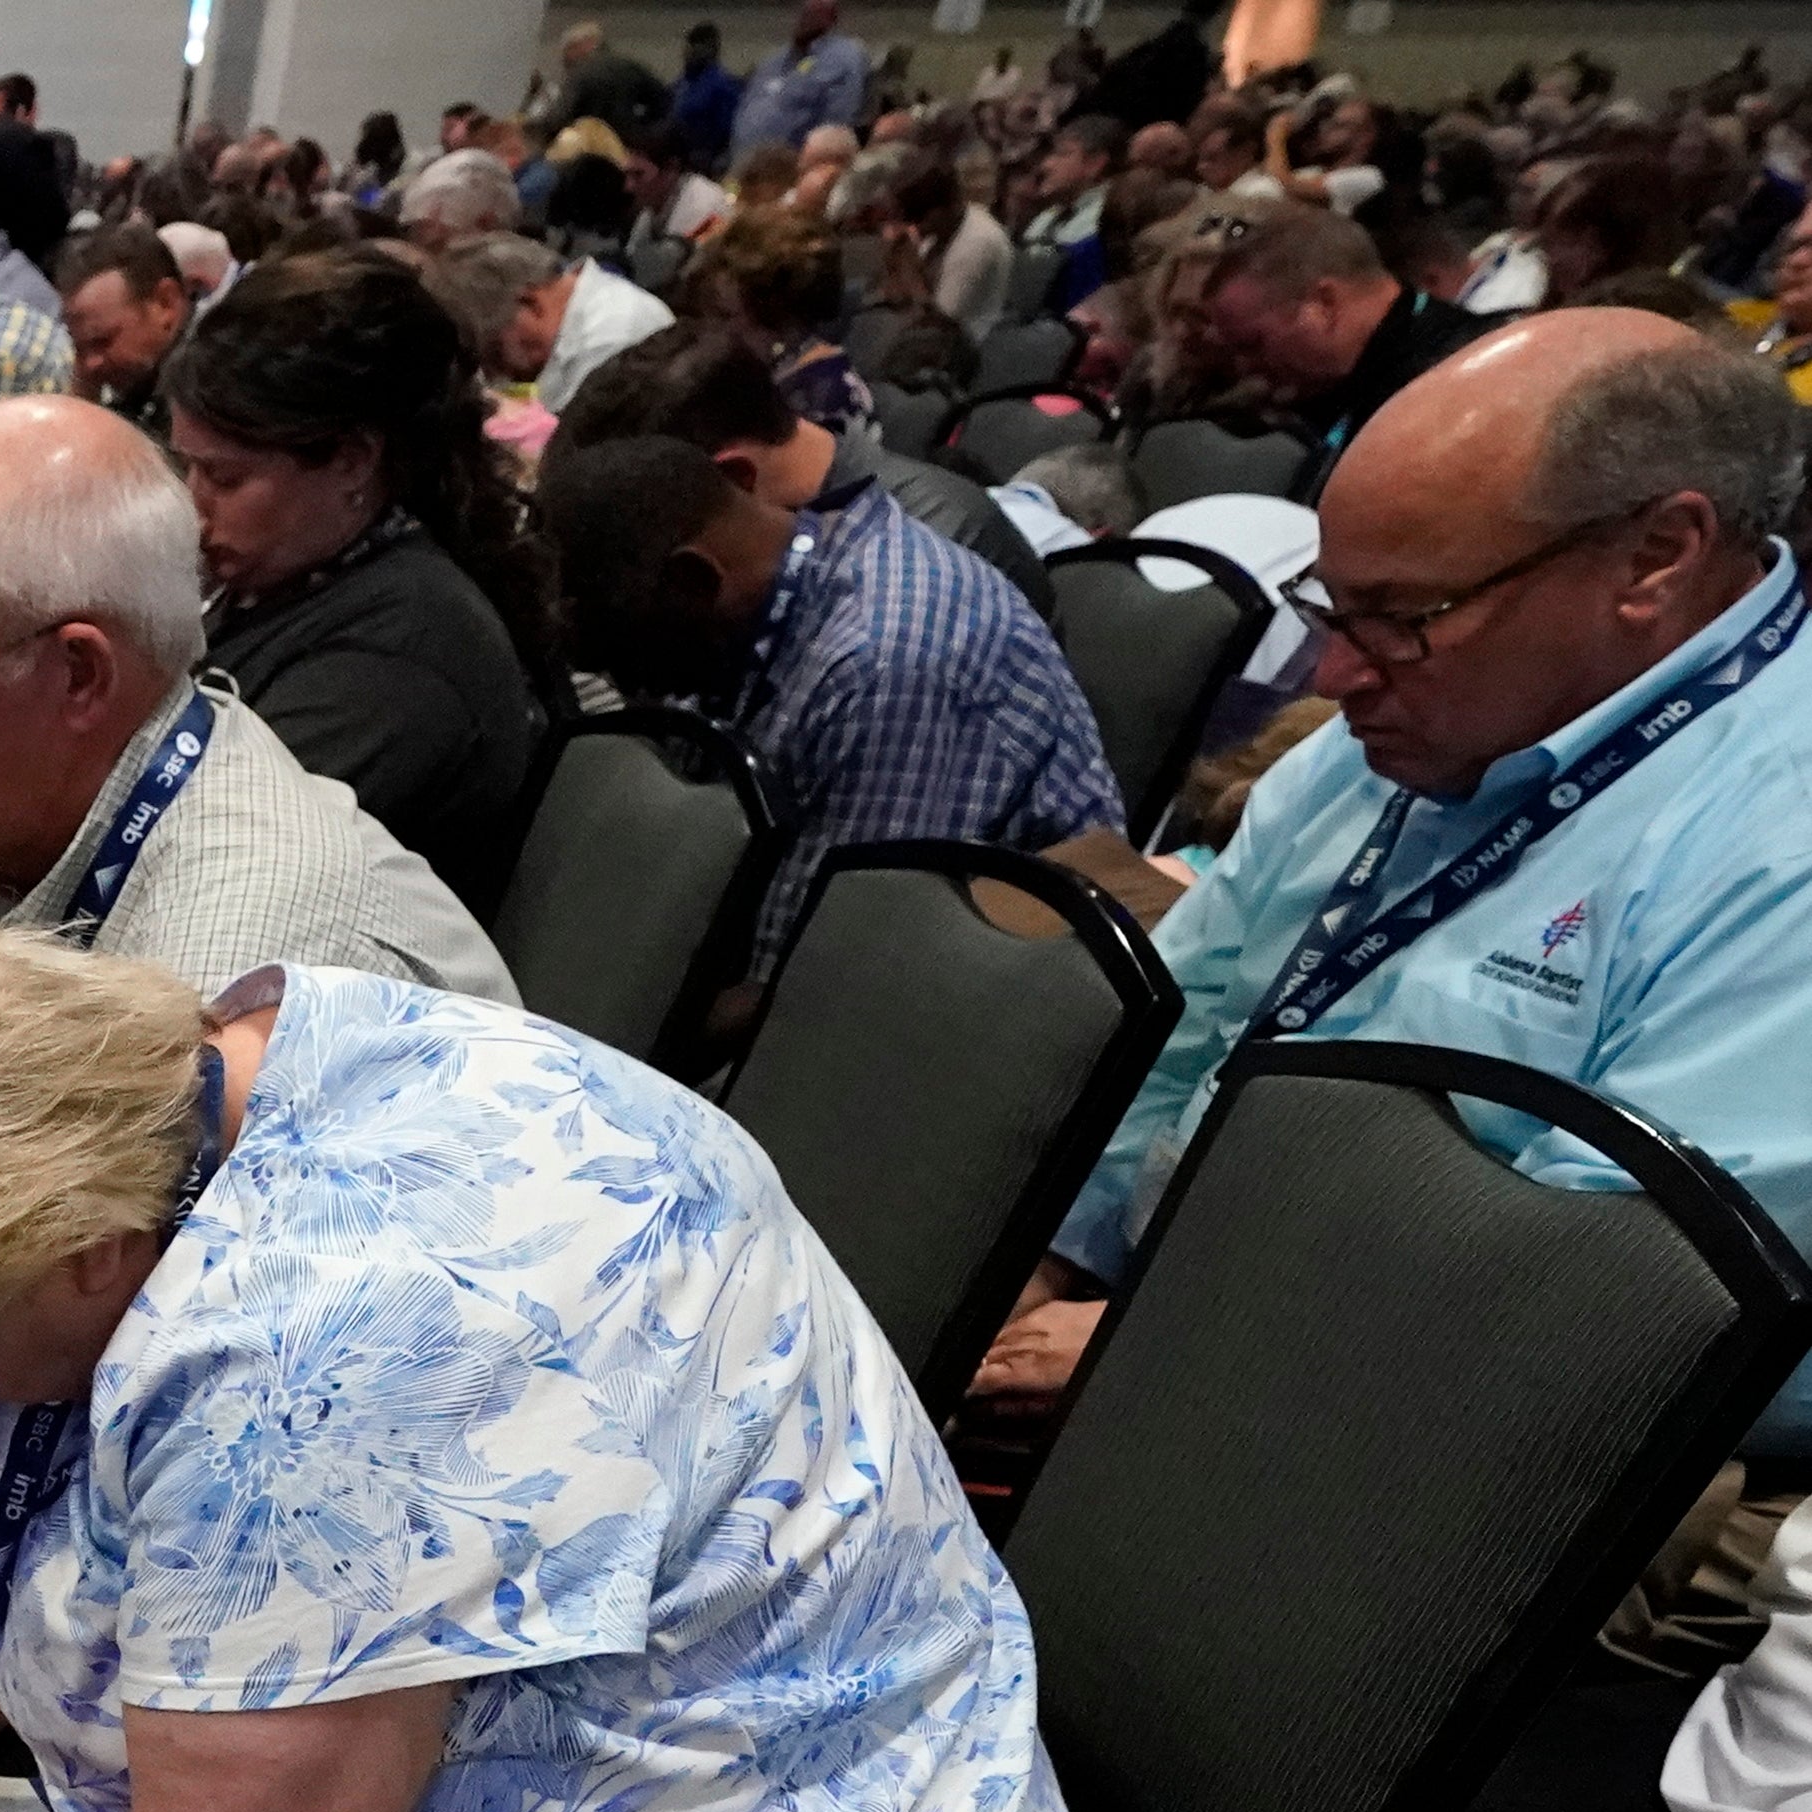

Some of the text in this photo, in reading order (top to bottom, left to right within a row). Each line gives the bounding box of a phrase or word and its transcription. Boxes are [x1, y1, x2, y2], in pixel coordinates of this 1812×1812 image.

[1636, 698, 1693, 741] imb
[121, 756, 189, 845] SBC imb
[1341, 931, 1388, 969] imb
[5, 1411, 54, 1521] SBC imb
